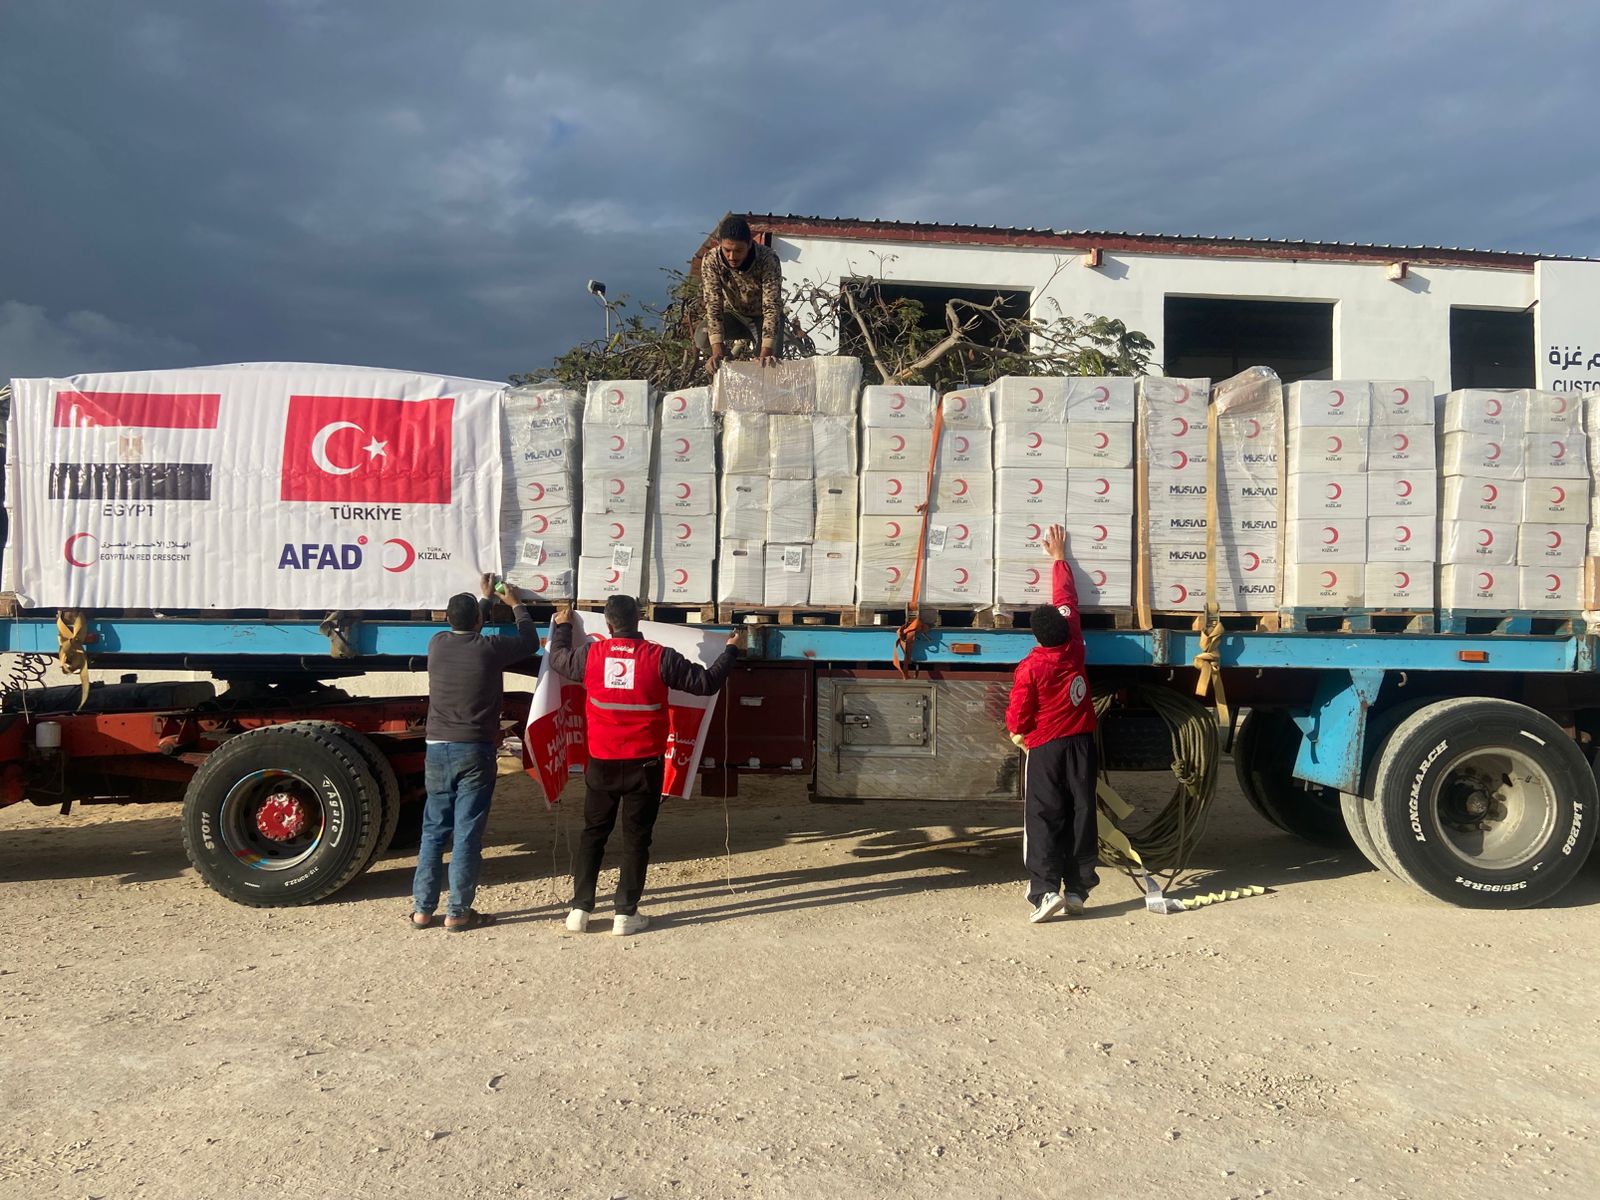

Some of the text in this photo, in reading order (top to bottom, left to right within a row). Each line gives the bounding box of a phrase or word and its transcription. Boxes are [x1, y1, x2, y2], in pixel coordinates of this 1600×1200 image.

[1549, 346, 1582, 370] غزة
[103, 504, 154, 517] EGYPT
[330, 505, 402, 520] TÜRKİYE
[278, 544, 363, 570] AFAD
[1409, 740, 1448, 842] LONGMARCH
[327, 791, 341, 832] Agate
